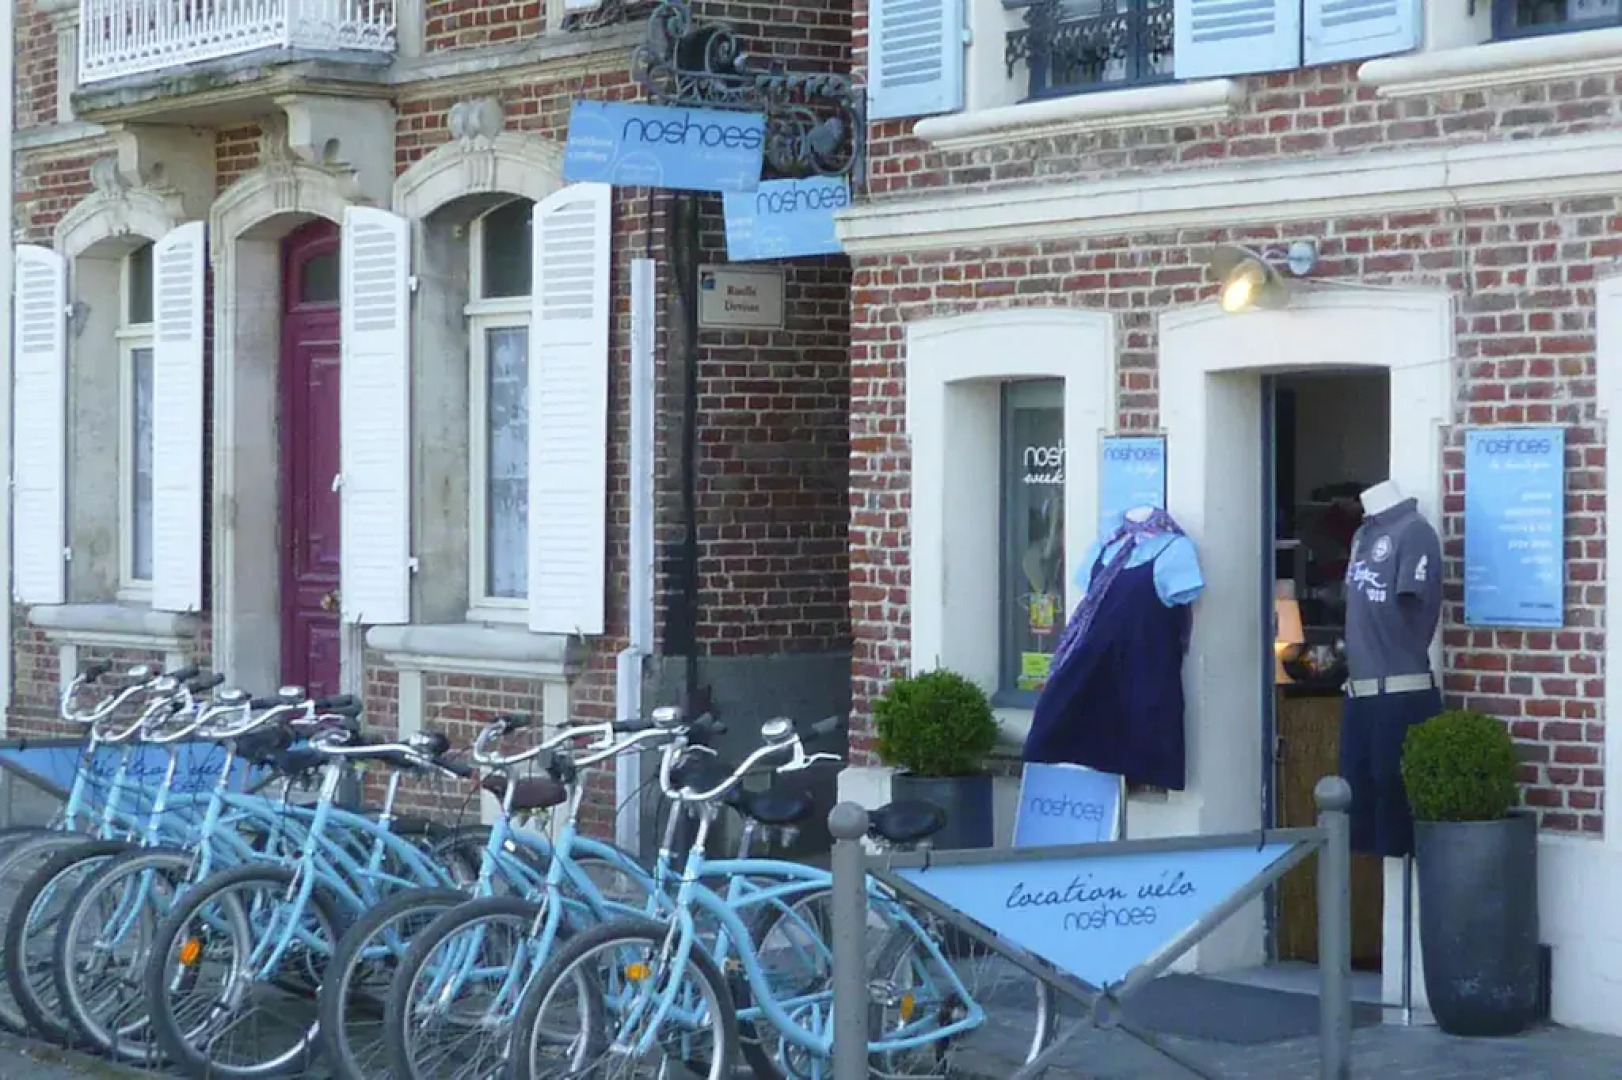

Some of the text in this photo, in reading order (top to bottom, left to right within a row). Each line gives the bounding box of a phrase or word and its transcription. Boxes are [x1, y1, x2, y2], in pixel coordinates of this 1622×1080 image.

[623, 111, 762, 148] noshoes
[756, 181, 847, 215] noshoes
[1477, 431, 1551, 456] noshoes
[1029, 792, 1105, 823] noshoes
[1006, 869, 1197, 909] location vélo
[1064, 902, 1157, 931] noshoes
